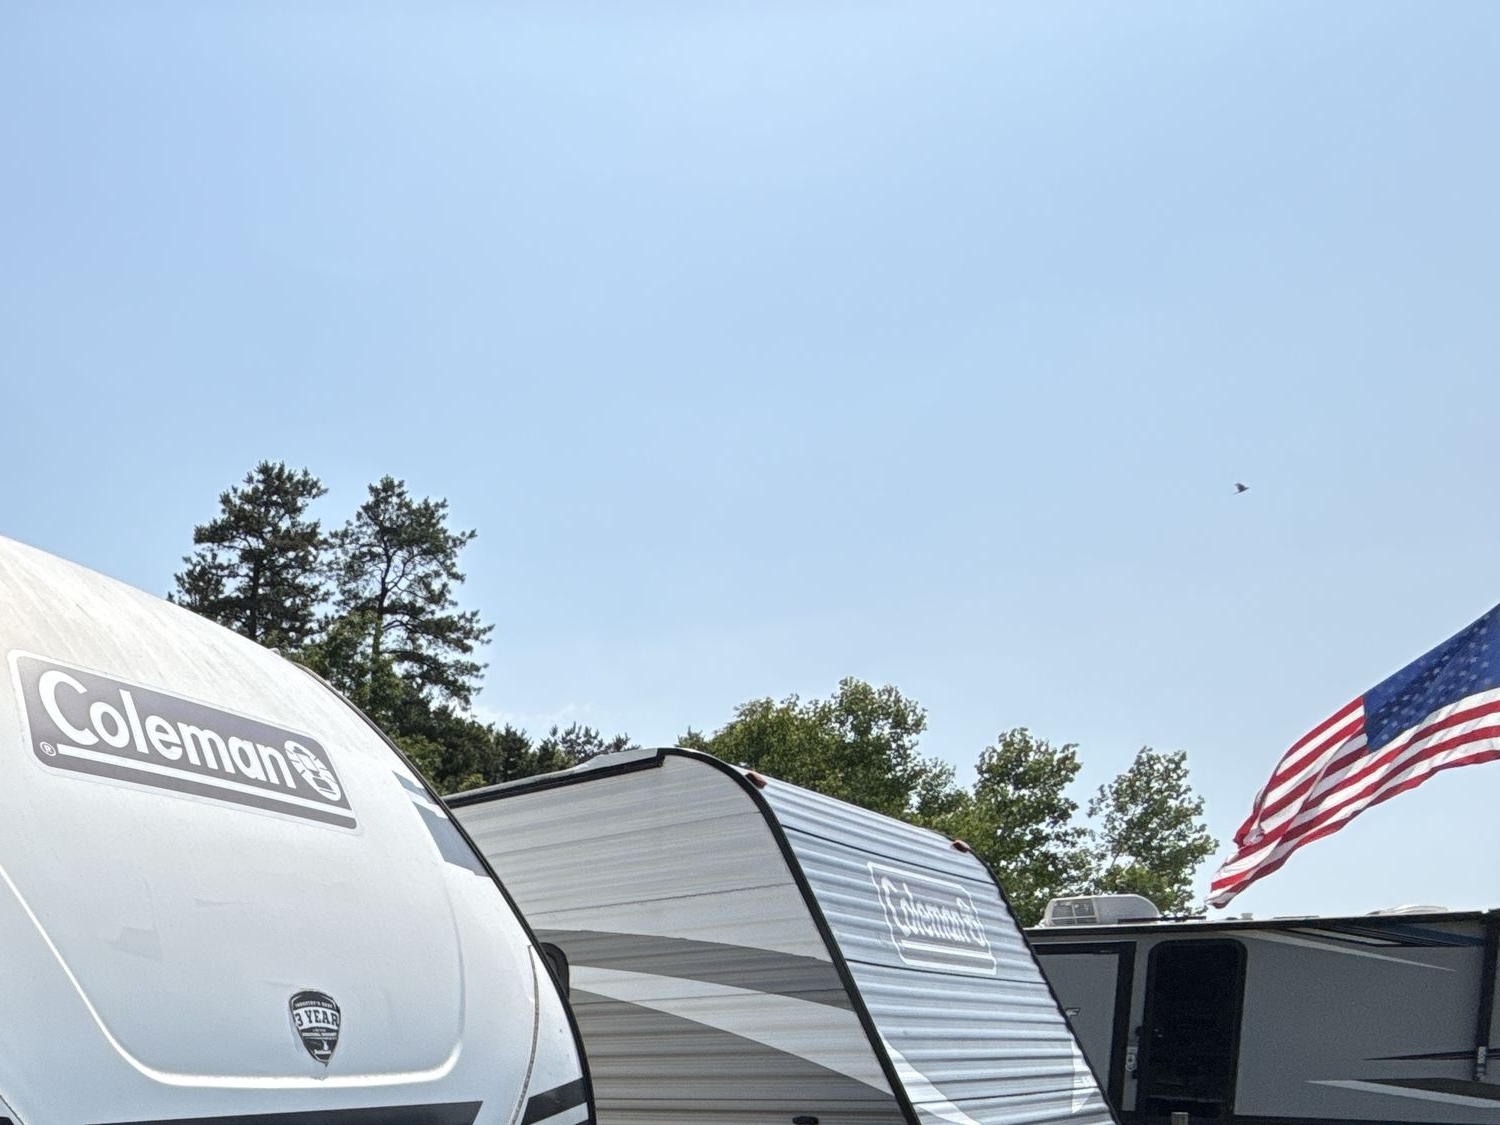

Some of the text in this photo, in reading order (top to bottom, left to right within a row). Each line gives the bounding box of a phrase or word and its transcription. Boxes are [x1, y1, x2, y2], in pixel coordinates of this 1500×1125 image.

[39, 671, 297, 788] Coleman
[882, 877, 970, 942] Coleman
[295, 1009, 339, 1027] 3 YEAR
